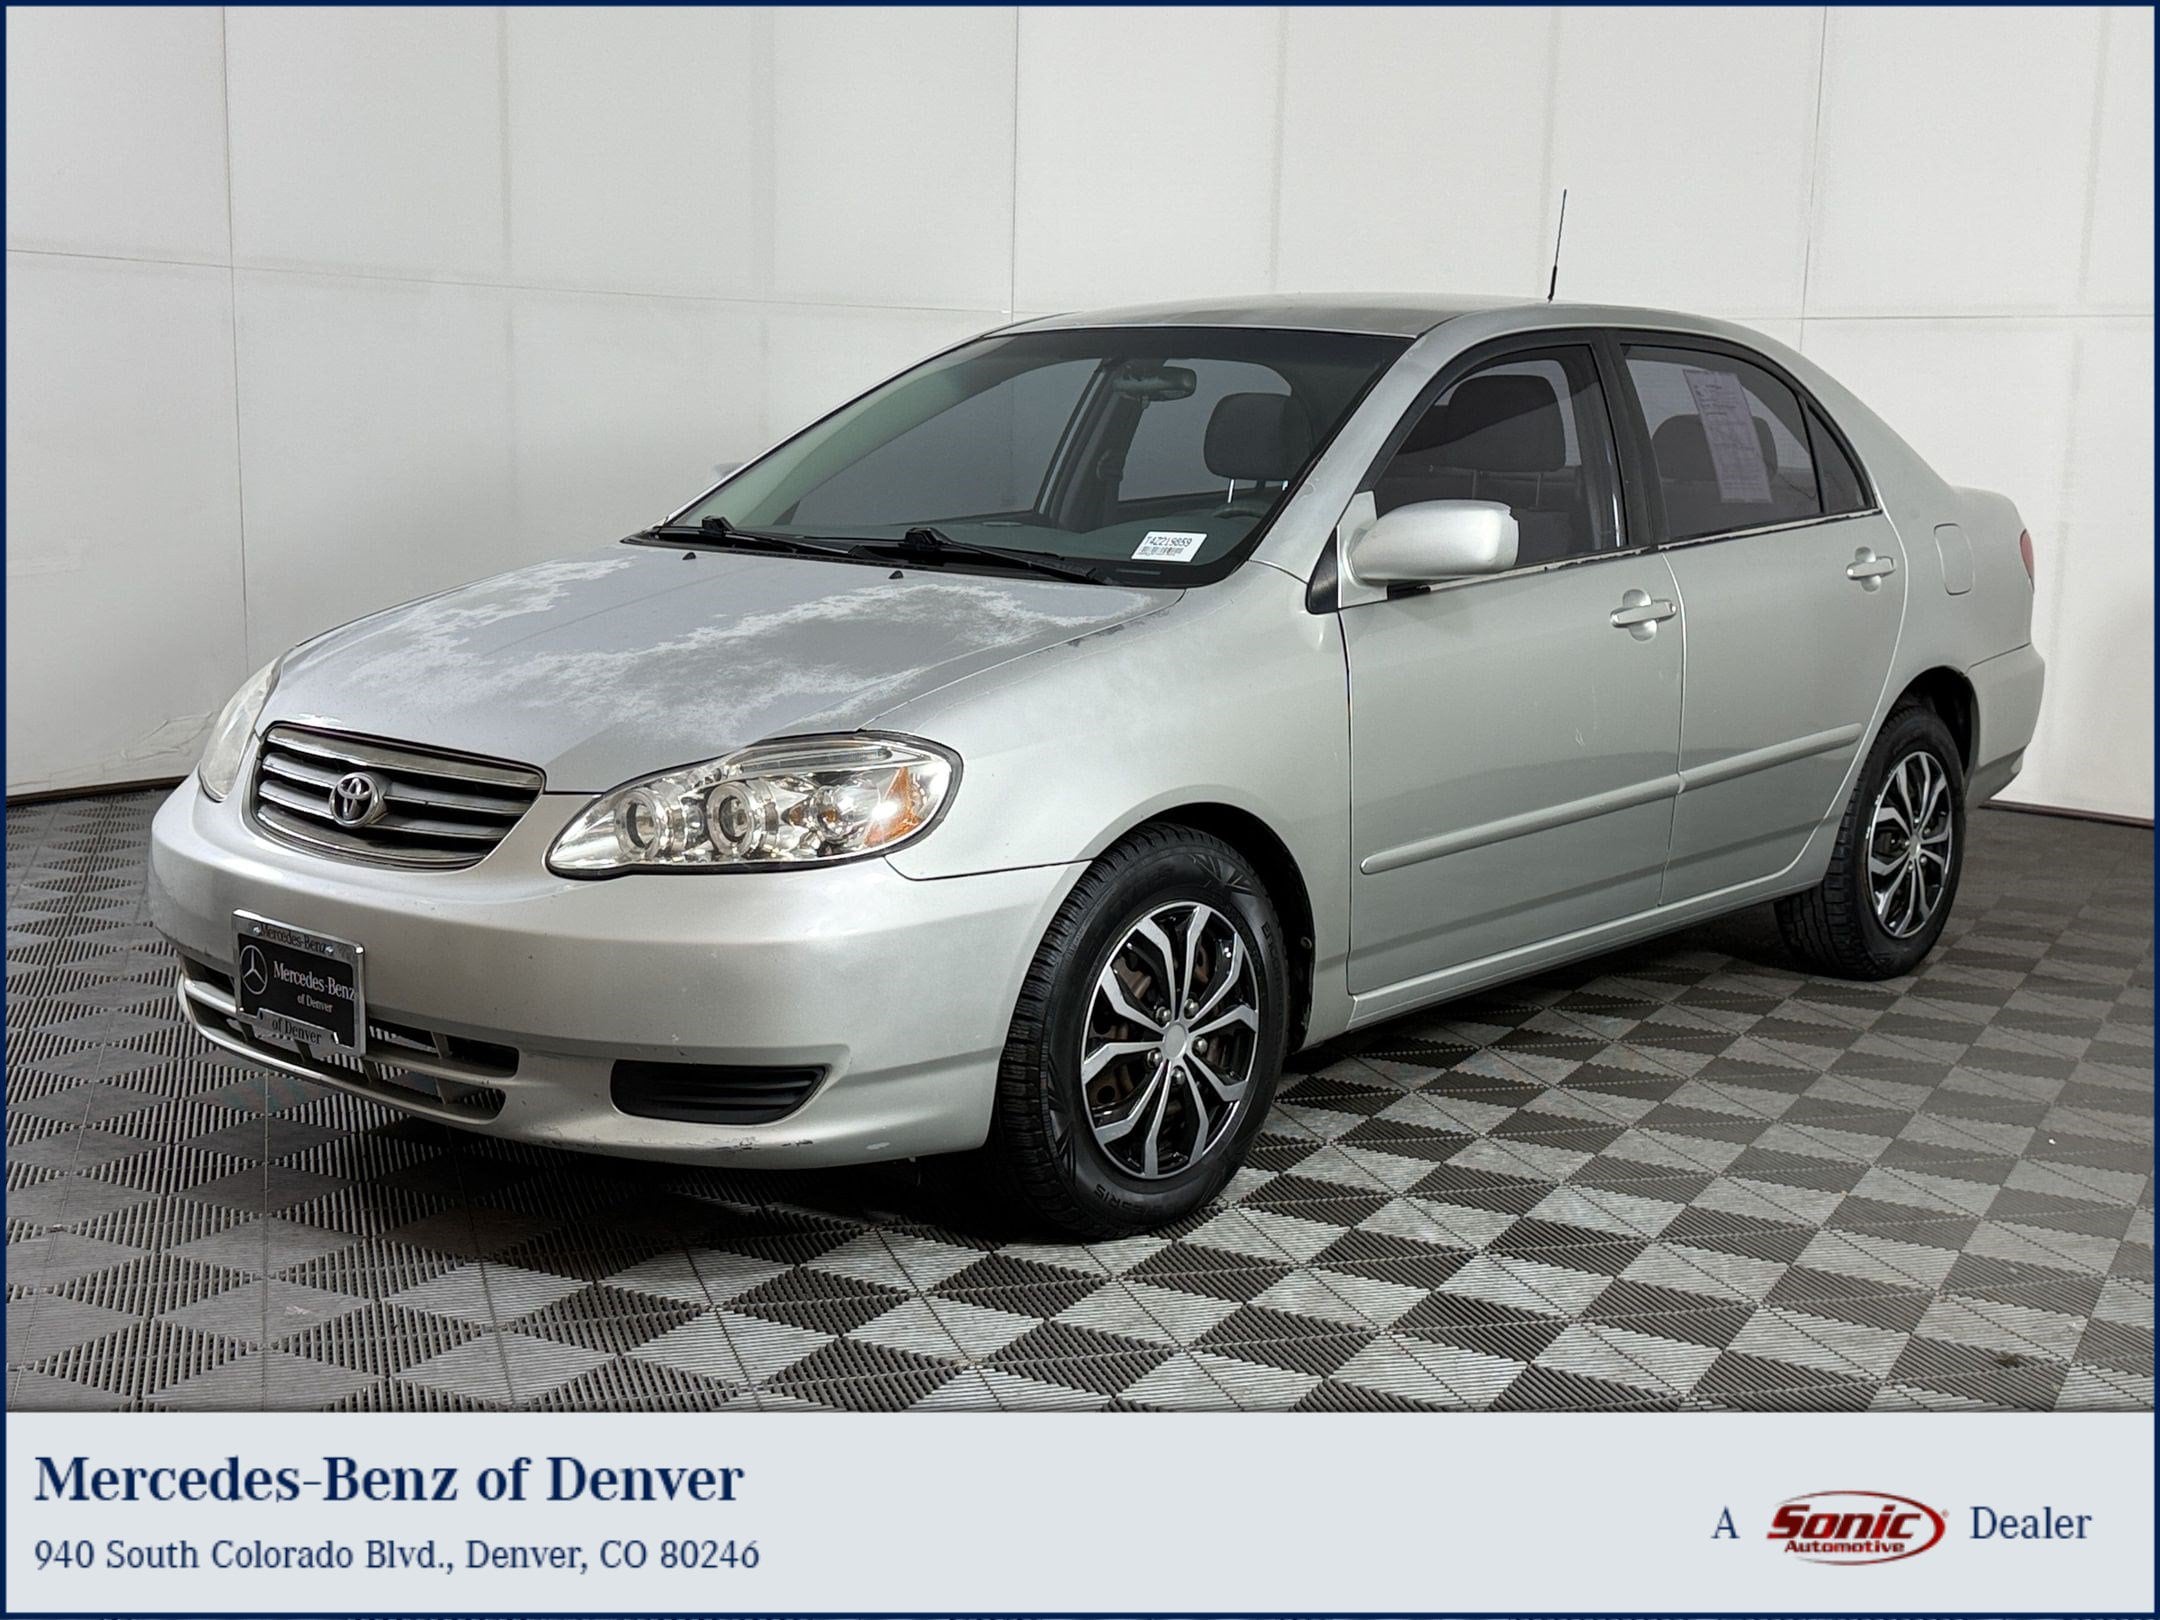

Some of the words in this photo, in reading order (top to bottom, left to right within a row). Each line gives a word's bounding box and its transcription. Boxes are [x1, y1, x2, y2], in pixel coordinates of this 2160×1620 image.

[273, 960, 355, 1000] Mercedes-Benz
[297, 993, 306, 1005] of
[306, 996, 334, 1013] Denver
[272, 1018, 283, 1031] of
[285, 1019, 322, 1044] Denver
